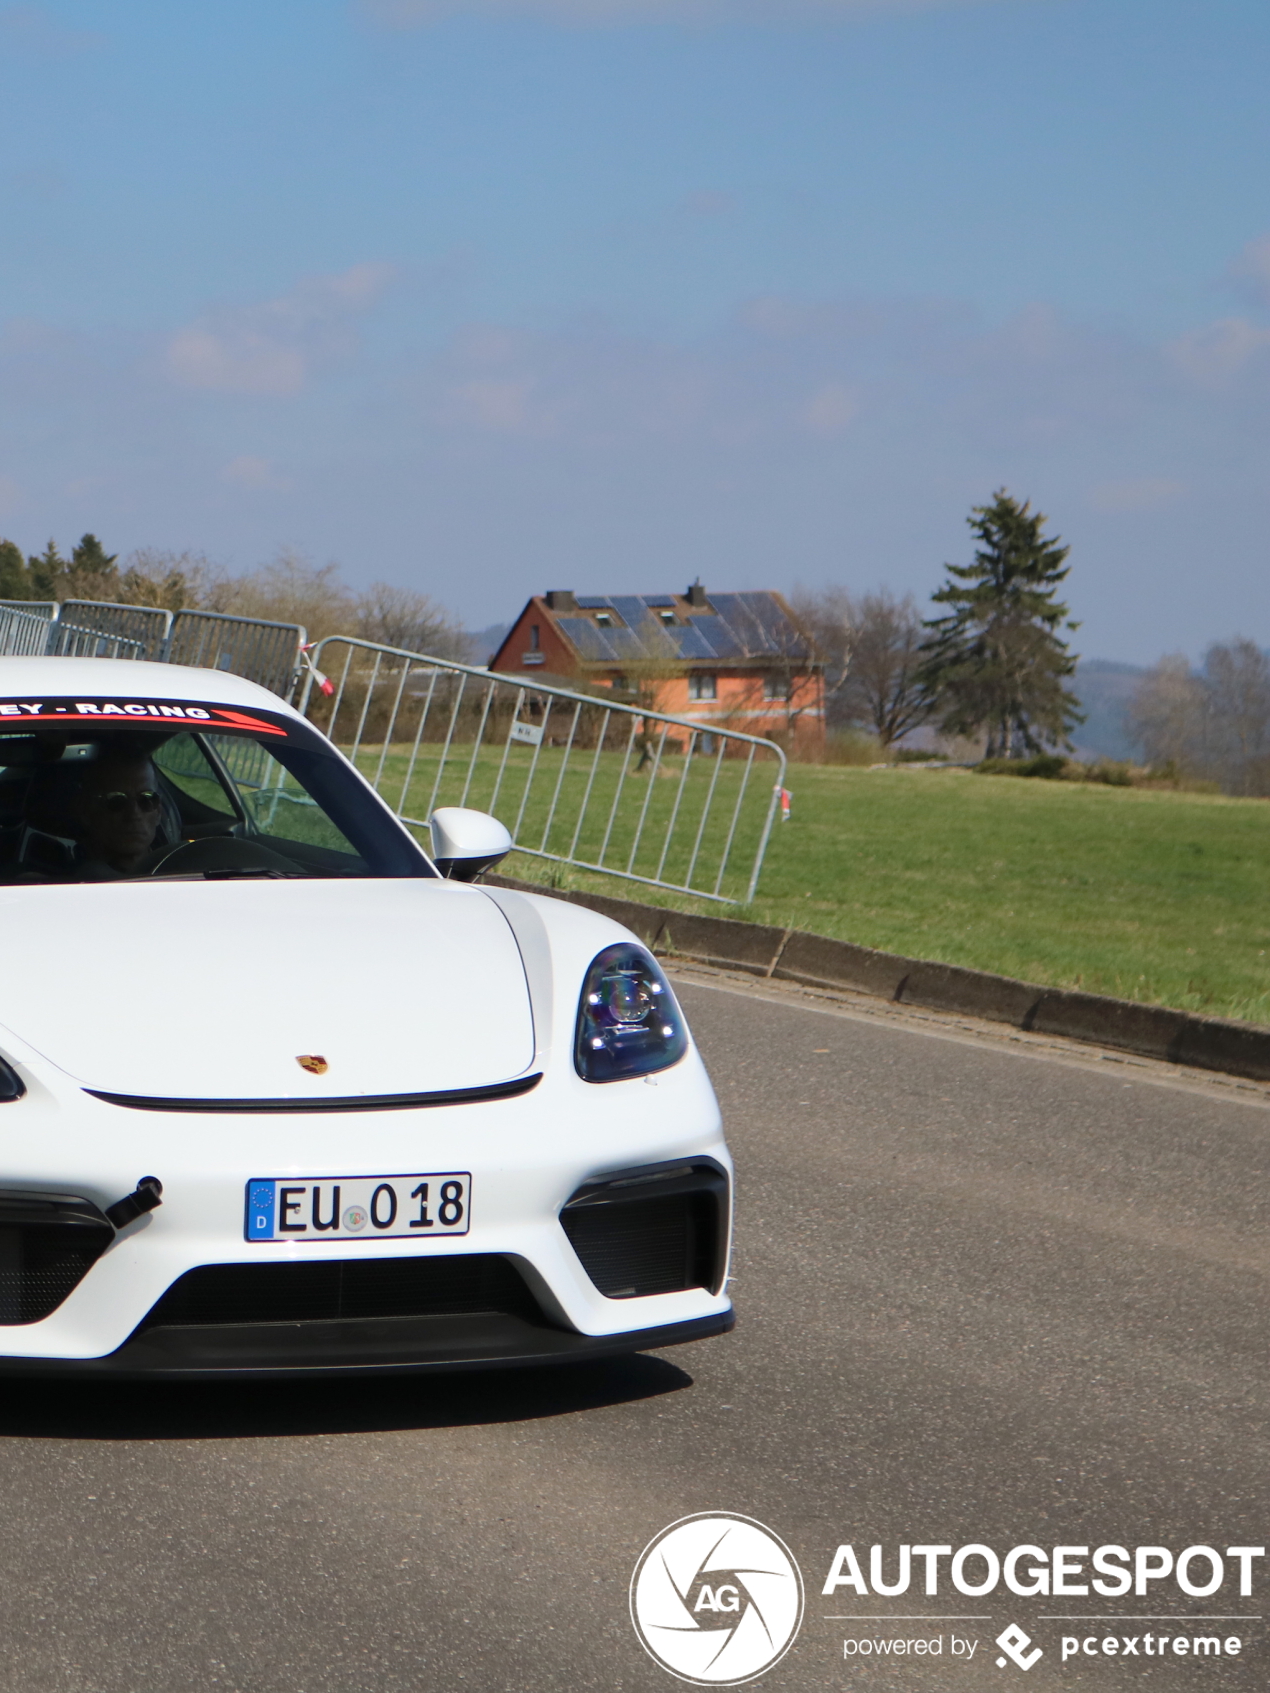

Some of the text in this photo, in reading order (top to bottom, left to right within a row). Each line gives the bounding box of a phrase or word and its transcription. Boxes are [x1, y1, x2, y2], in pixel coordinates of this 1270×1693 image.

[75, 702, 212, 720] RACING
[279, 1186, 341, 1232] EU
[409, 1180, 464, 1228] 18
[256, 1216, 267, 1229] D
